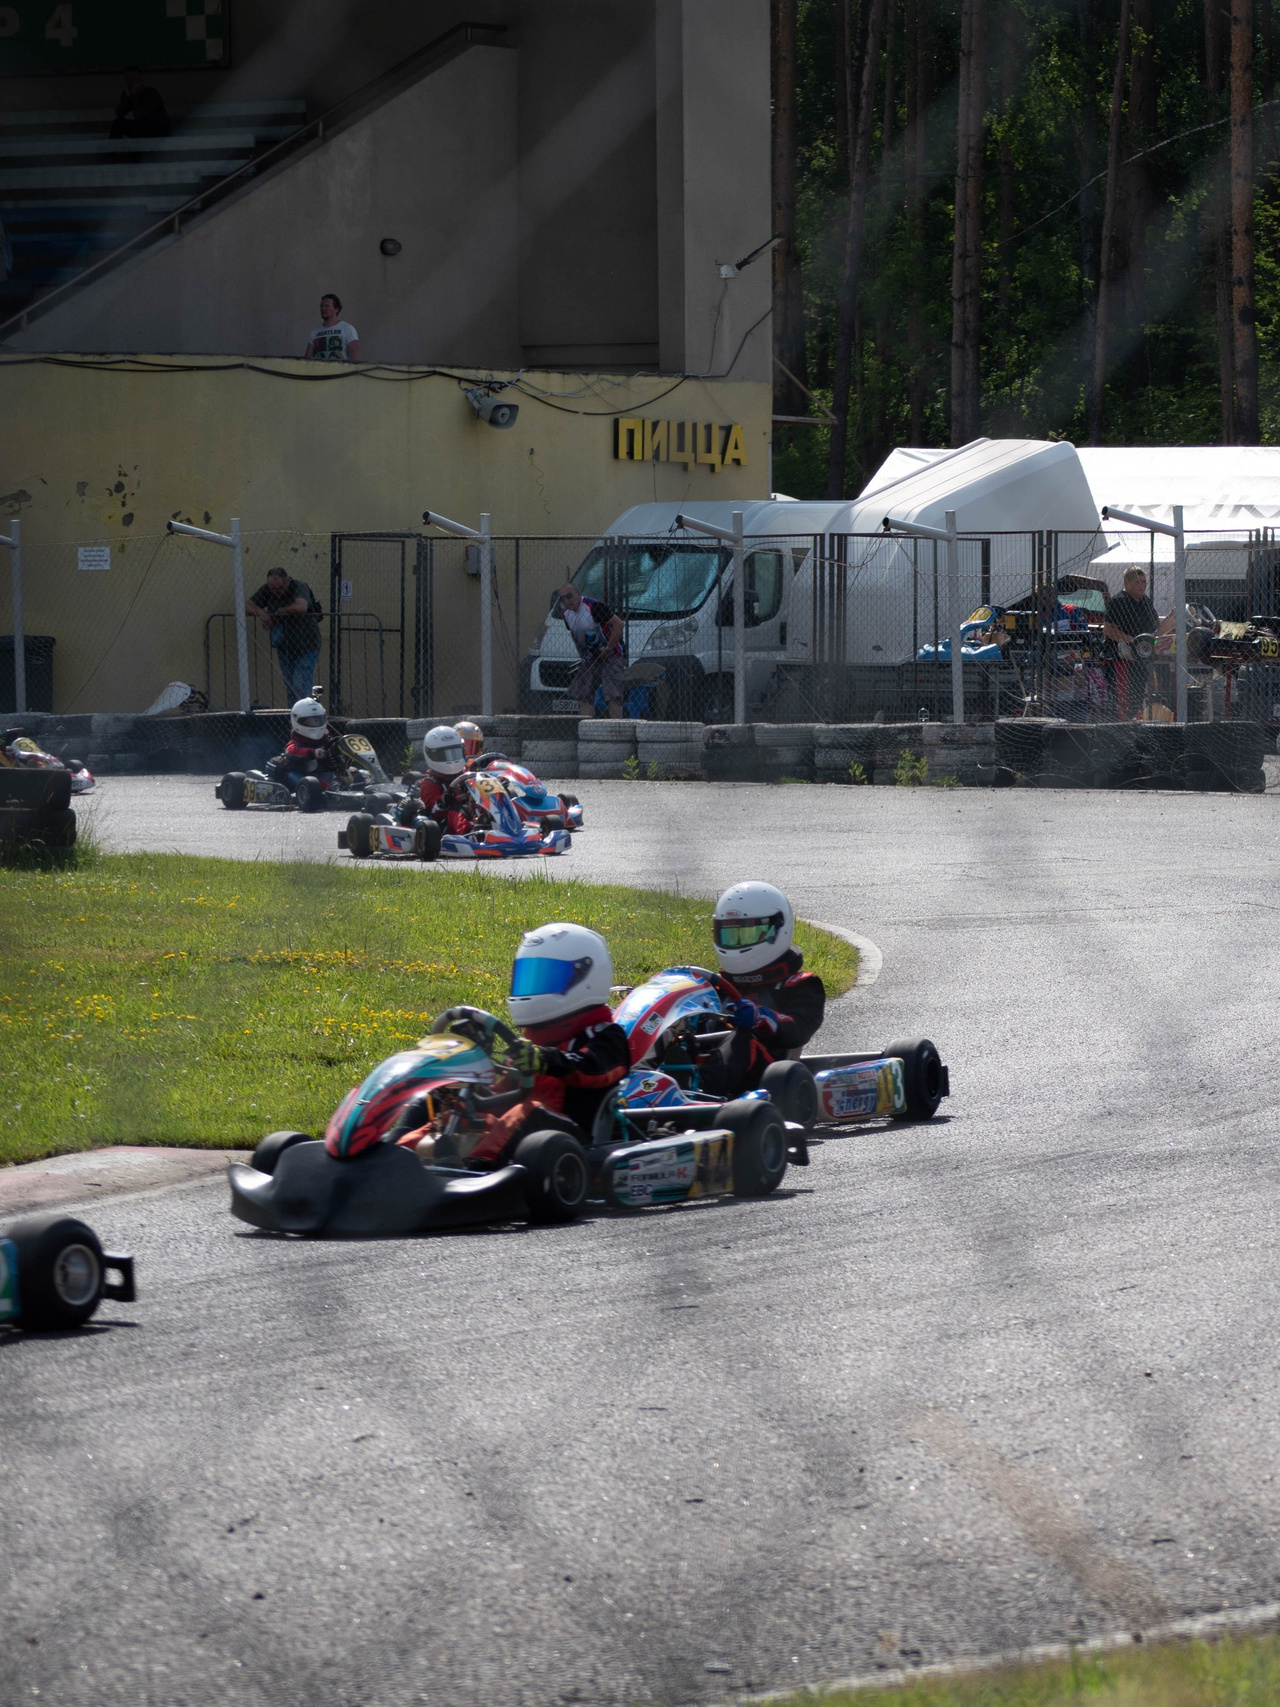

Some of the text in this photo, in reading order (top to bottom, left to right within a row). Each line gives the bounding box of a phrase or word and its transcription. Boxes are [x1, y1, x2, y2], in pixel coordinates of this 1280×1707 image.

[45, 3, 78, 47] 4
[616, 418, 748, 472] ПИЦЦА
[1263, 638, 1278, 654] 95
[347, 737, 371, 752] 69
[891, 1060, 905, 1109] 3
[631, 1184, 653, 1197] EBC
